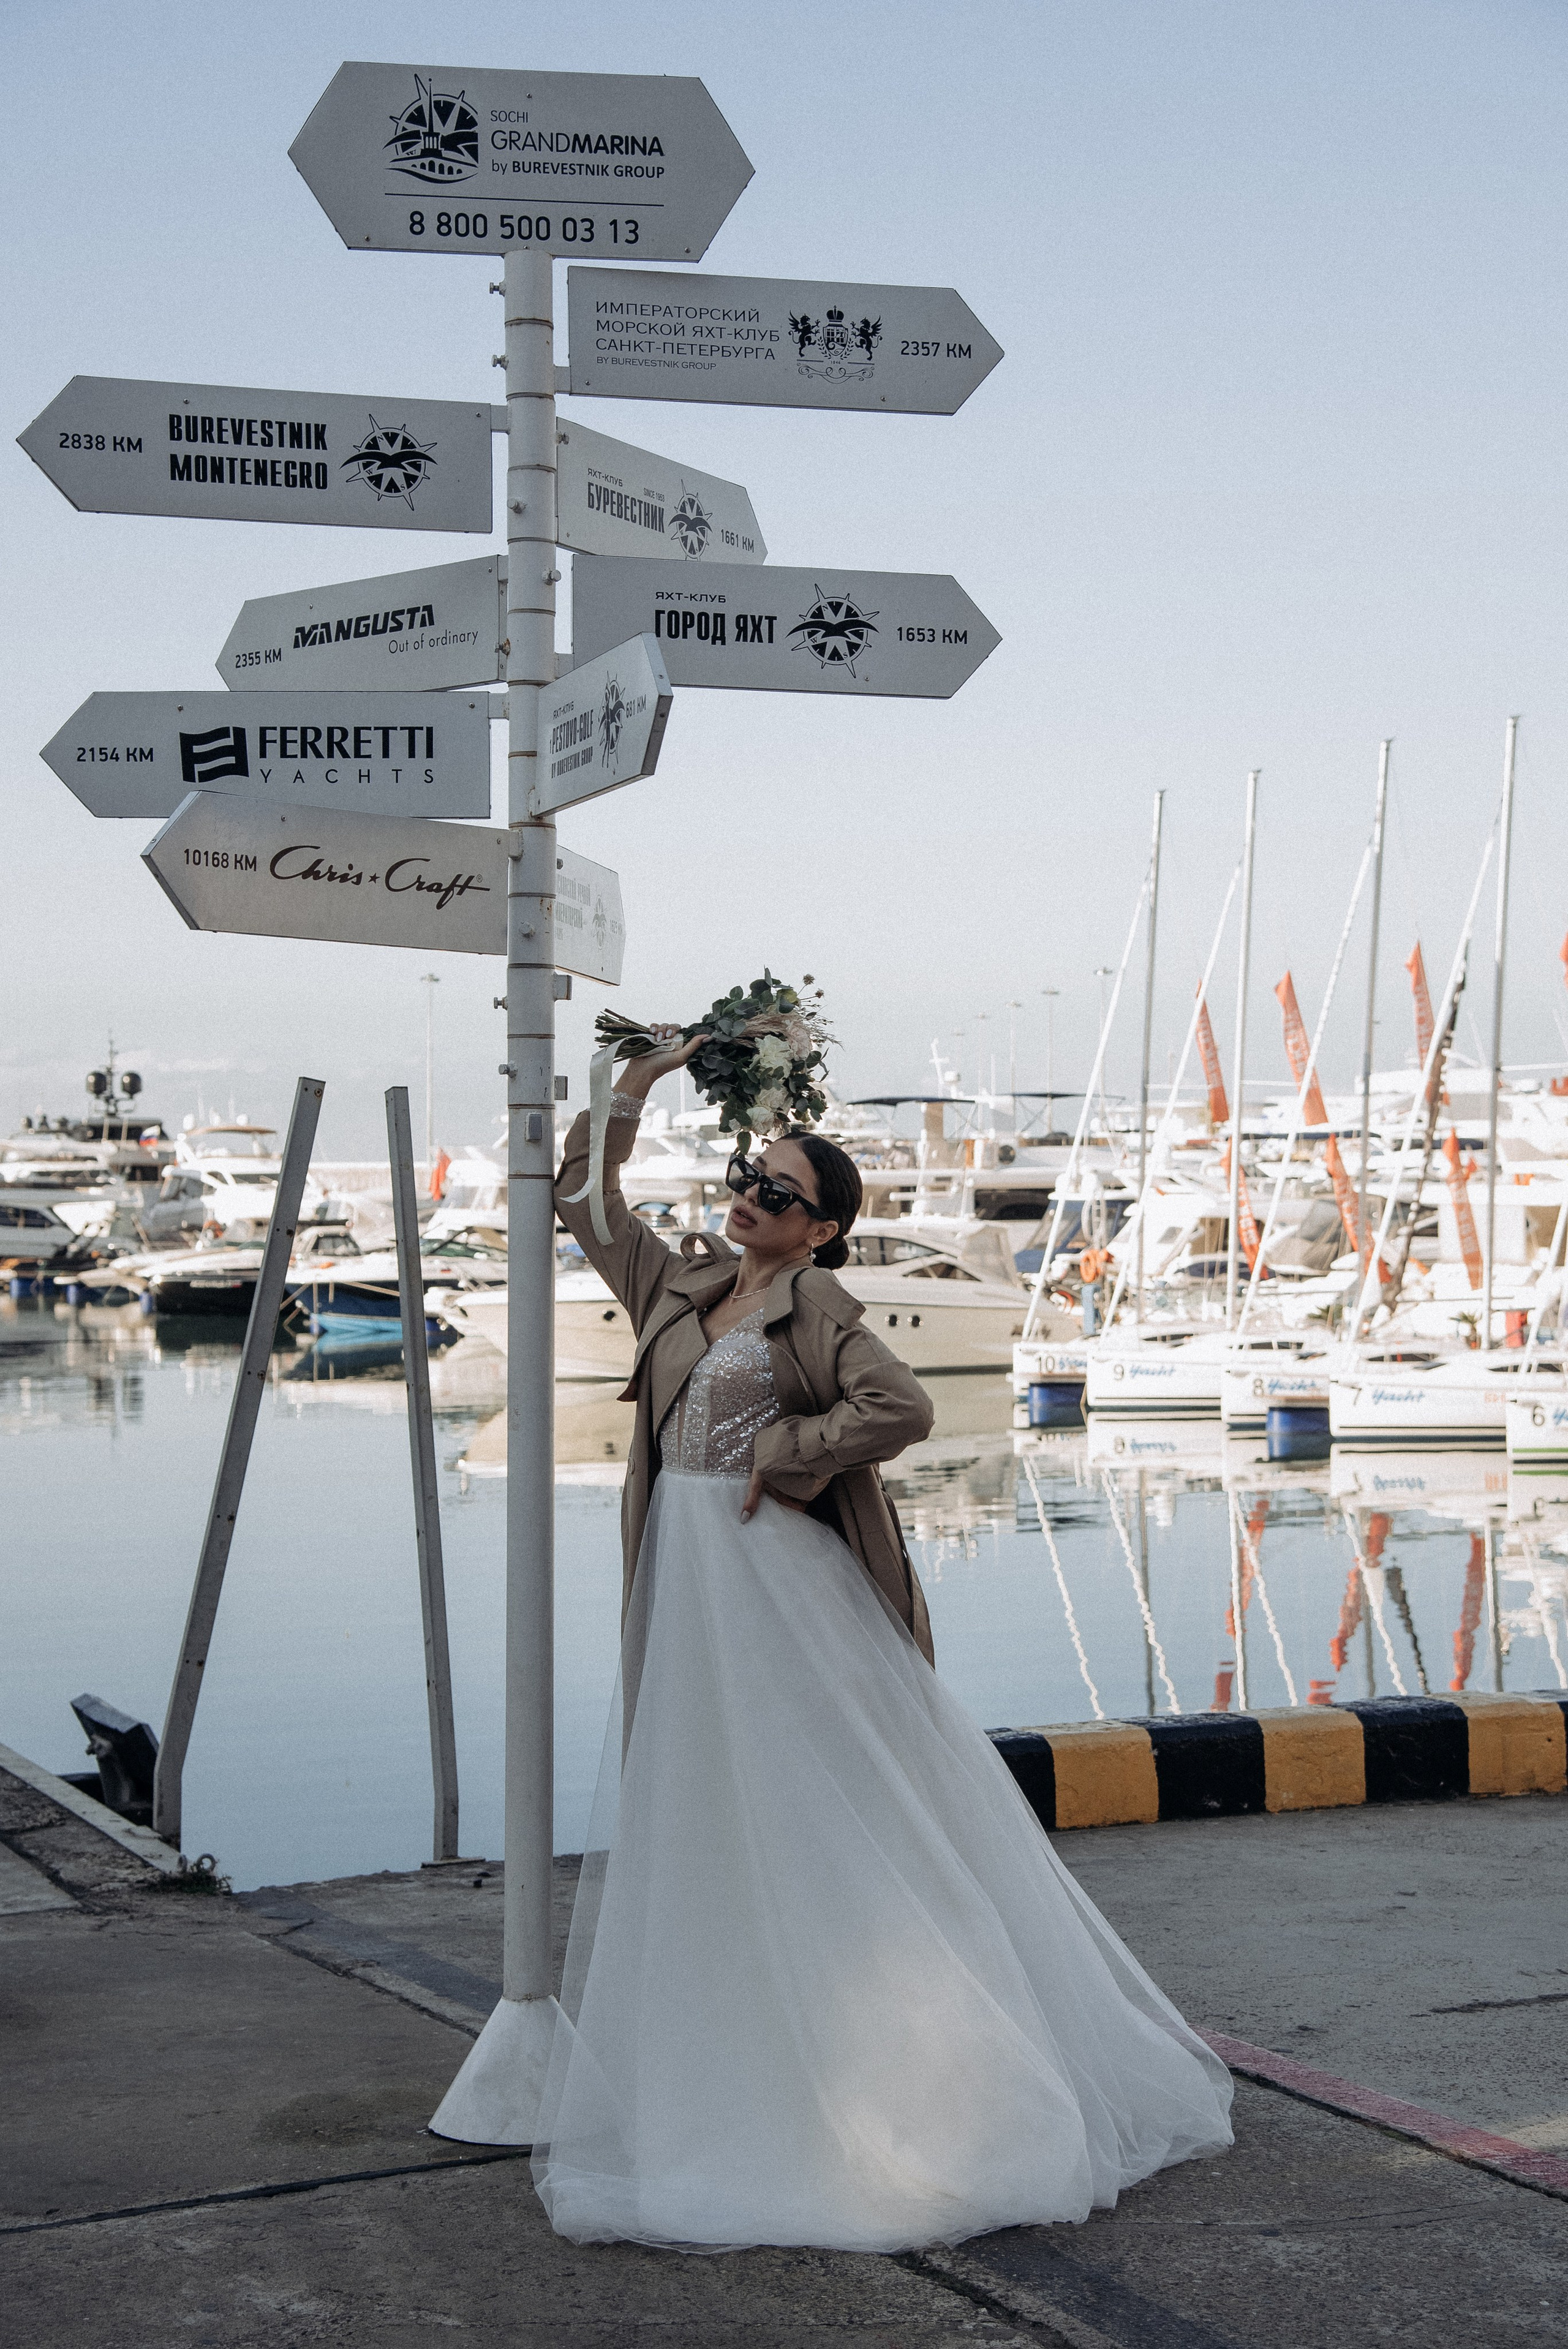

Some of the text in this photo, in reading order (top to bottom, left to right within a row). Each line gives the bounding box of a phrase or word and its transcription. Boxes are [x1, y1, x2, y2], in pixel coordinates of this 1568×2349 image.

[490, 110, 529, 123] SOCHI
[491, 130, 665, 157] GRANDMARINA
[492, 159, 665, 179] by BUREVESTNIK GROUP
[409, 211, 639, 244] 8 800 500 03 13
[595, 301, 760, 323] ИМПЕРАТОРСКИЙ
[595, 319, 780, 343] МОРСКОЙ ЯХТ-КЛУБ
[595, 338, 775, 361] САНКТ-ПЕТЕРБУРГА
[900, 340, 940, 357] 2357
[597, 356, 717, 370] BY BUREVESTNIK GROUP
[59, 432, 106, 451] 2838
[168, 413, 328, 451] BUREVESTNIK
[170, 453, 328, 491] MONTENEGRO
[587, 468, 623, 487] ЯХТ-КЛУБ
[587, 481, 665, 534] БУРЕВЕСТНИК
[721, 529, 739, 548] 1661
[655, 591, 726, 603] ЯХТ-КЛУБ
[293, 604, 435, 649] MANGUSTA
[655, 609, 778, 646] ГОРОД ЯХТ
[897, 626, 936, 643] 1653
[388, 630, 479, 654] Out of ordinary
[235, 650, 262, 669] 2355
[552, 709, 594, 754] PESTOVO-GOLF
[258, 726, 434, 759] FERRETTI
[76, 747, 121, 763] 2154
[259, 769, 434, 784] YACHTS
[183, 848, 230, 870] 10168
[270, 845, 363, 886] Chris
[385, 858, 491, 910] Craft
[1036, 1355, 1055, 1373] 10
[1114, 1363, 1125, 1381] 9
[1254, 1378, 1264, 1397] 8
[1351, 1386, 1362, 1406] 7
[1532, 1405, 1545, 1427] 6
